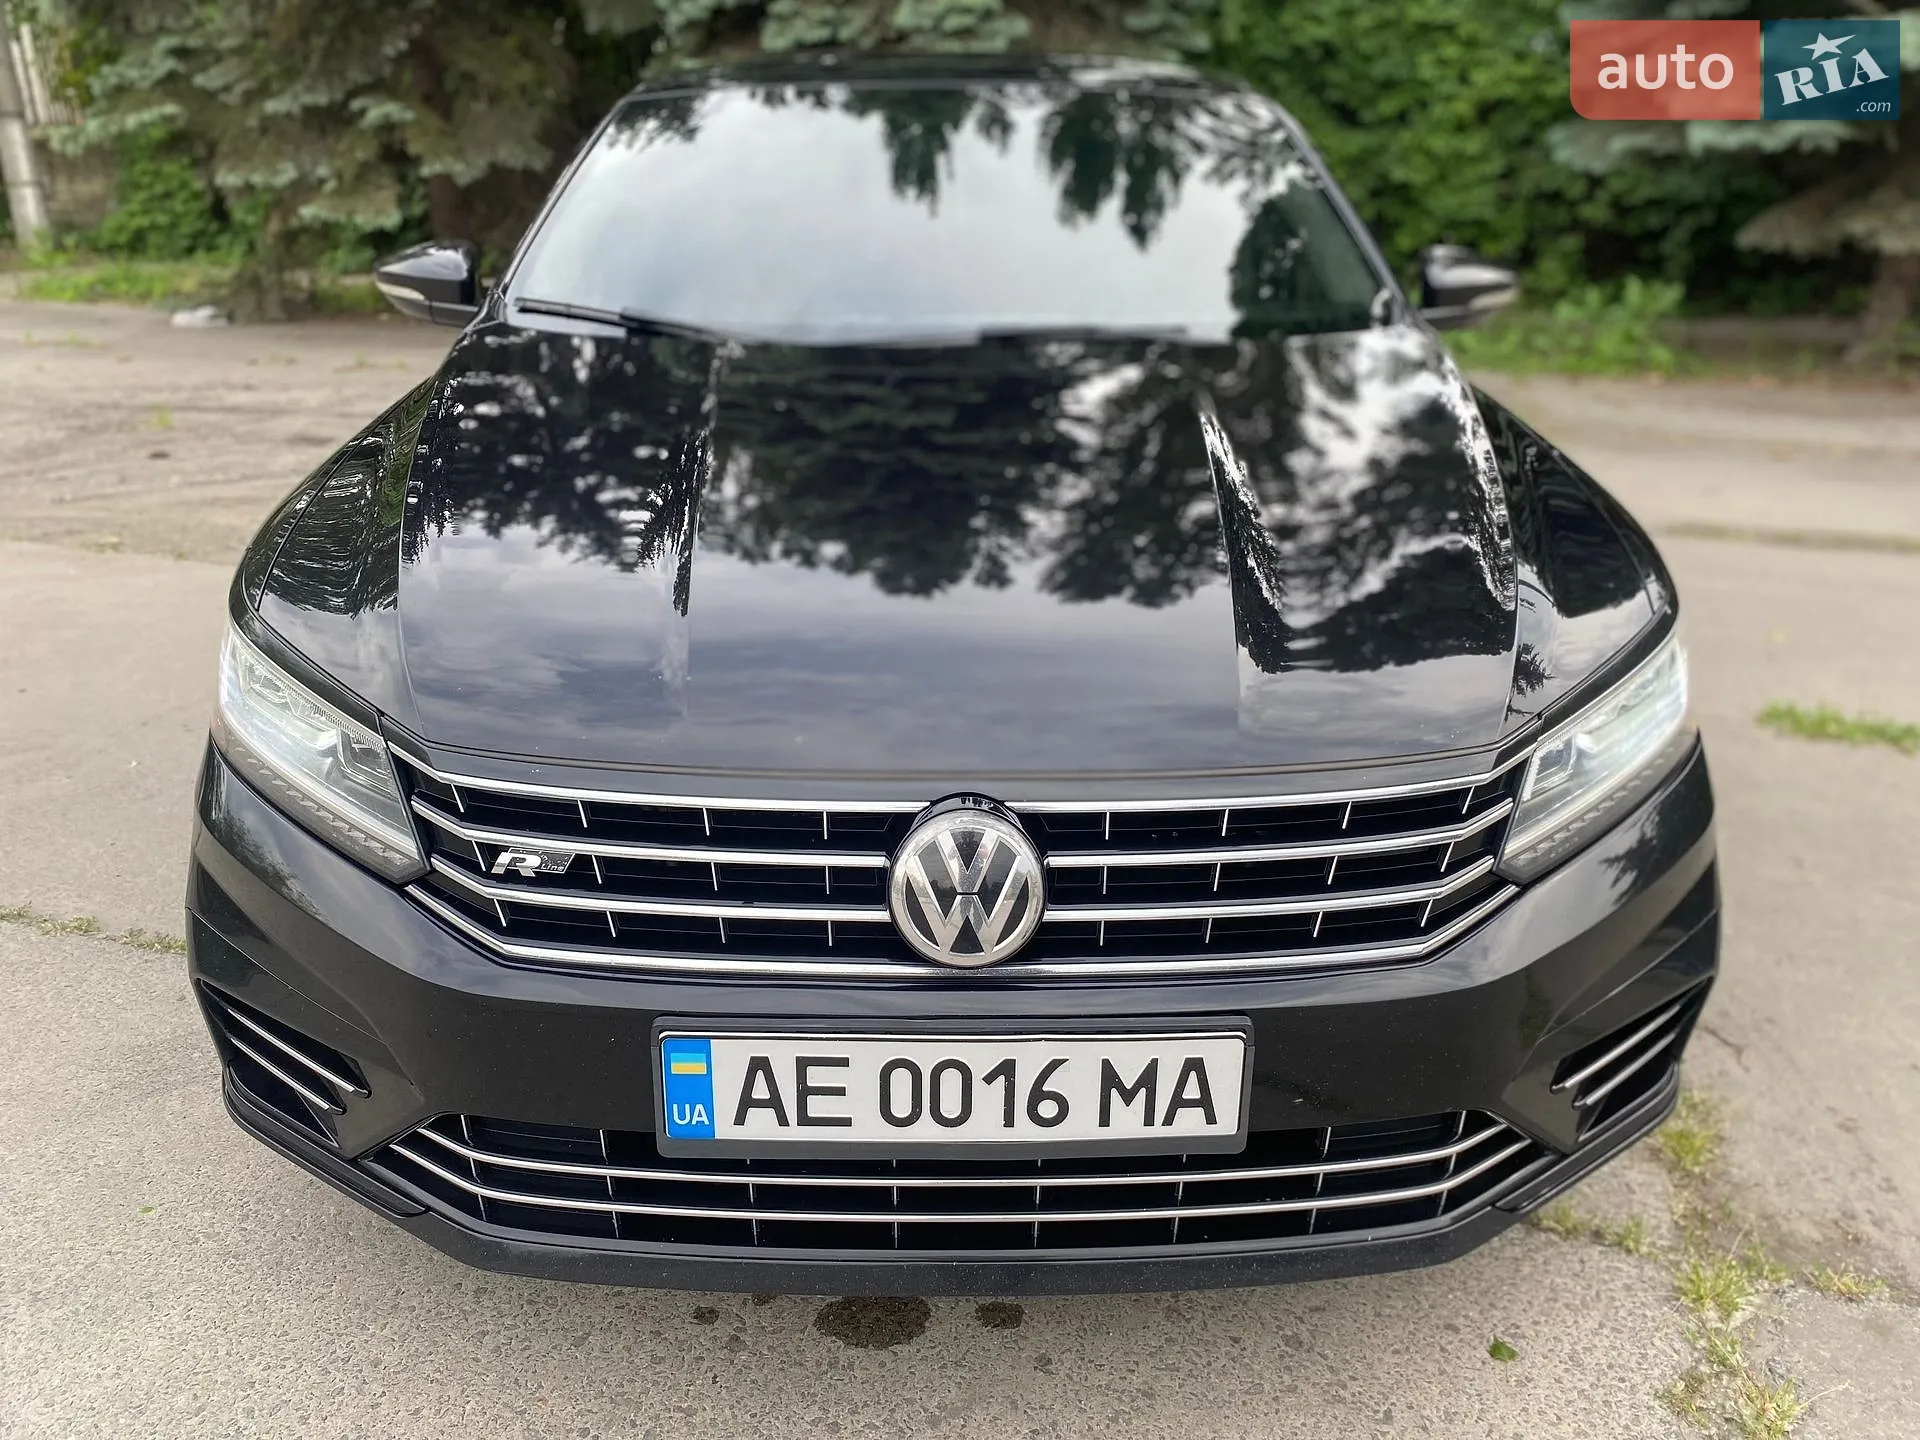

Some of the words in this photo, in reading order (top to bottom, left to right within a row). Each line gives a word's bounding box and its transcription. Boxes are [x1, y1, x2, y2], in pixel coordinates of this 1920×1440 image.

[490, 851, 542, 877] R
[732, 1055, 853, 1128] AE
[879, 1057, 1071, 1128] 0016
[1097, 1056, 1218, 1128] MA
[672, 1104, 710, 1126] UA
